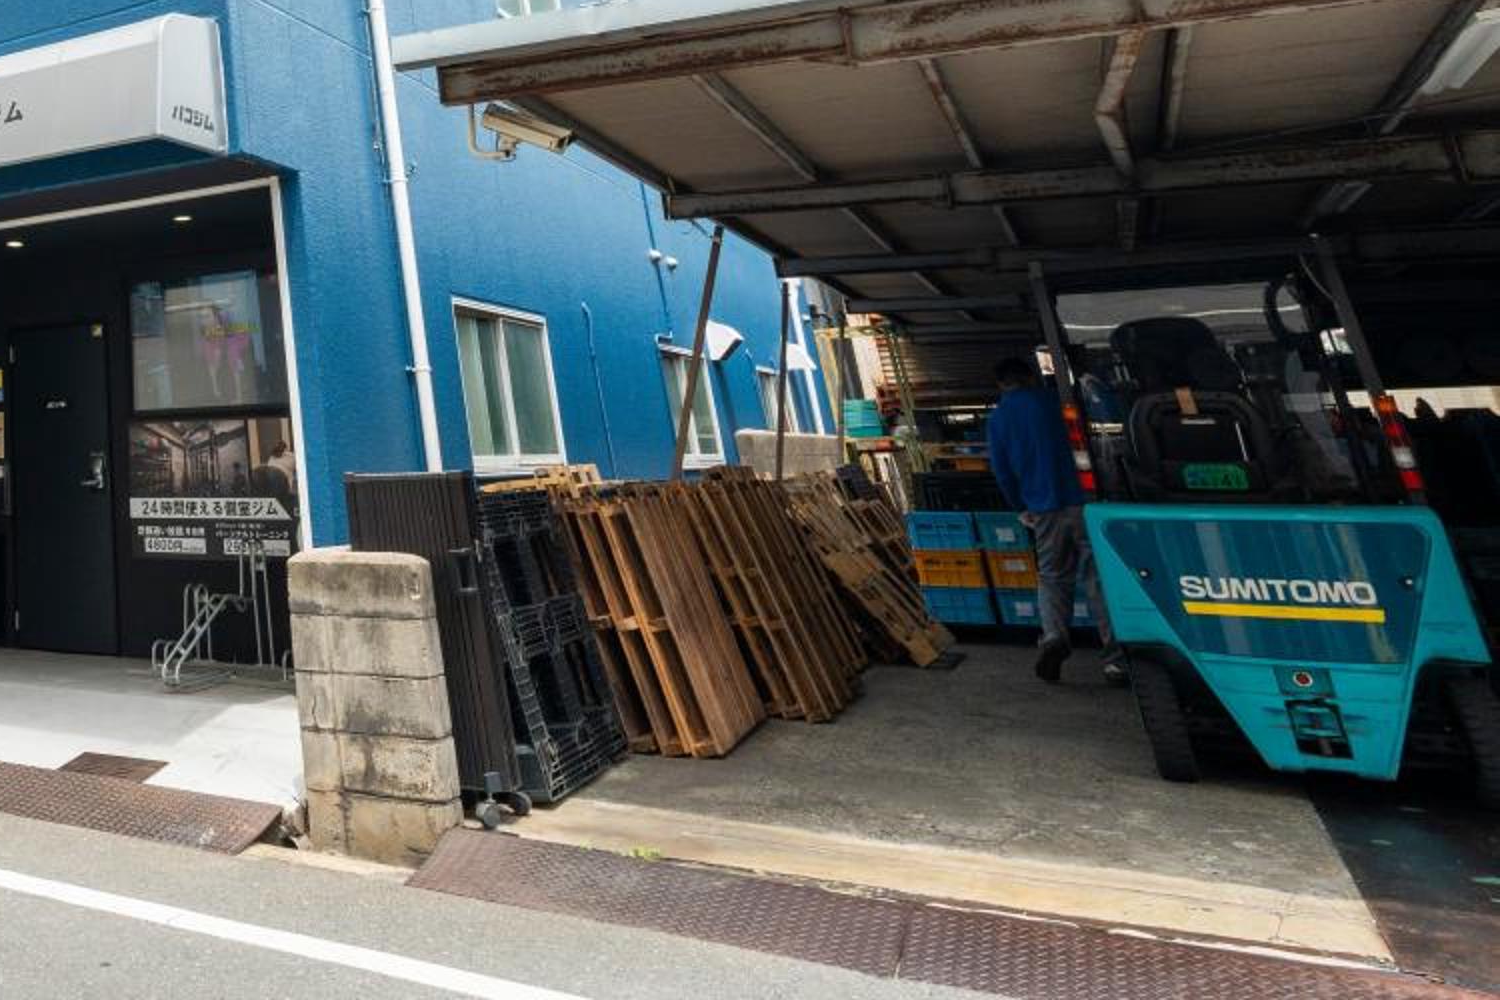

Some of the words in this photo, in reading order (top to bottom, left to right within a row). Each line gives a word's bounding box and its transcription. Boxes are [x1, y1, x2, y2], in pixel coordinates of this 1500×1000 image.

[171, 105, 214, 131] ハコジム
[1179, 575, 1378, 605] SUMITOMO
